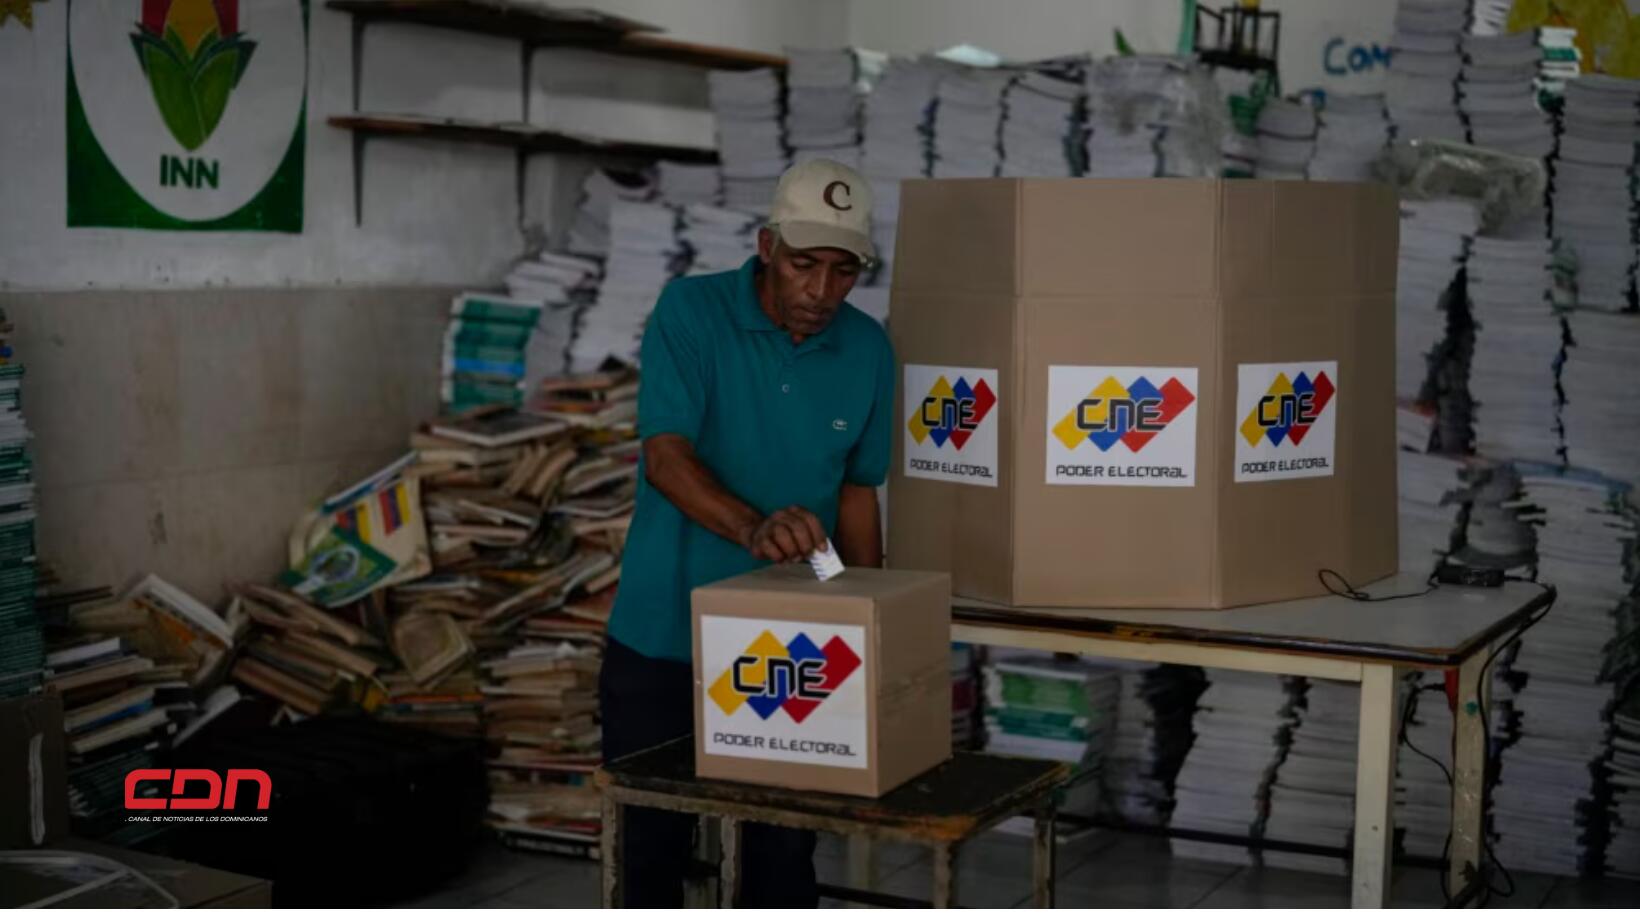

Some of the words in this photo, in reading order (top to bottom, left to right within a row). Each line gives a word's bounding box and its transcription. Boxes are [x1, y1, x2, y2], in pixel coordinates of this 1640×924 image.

[160, 153, 219, 190] INN
[822, 180, 852, 211] C
[921, 396, 979, 430] CNE
[1076, 398, 1168, 431] CNE
[1258, 393, 1318, 427] CNE
[909, 458, 940, 473] PODER
[1055, 464, 1105, 478] PODER
[1107, 465, 1188, 479] ELECTORAL
[1241, 460, 1277, 474] PODER
[732, 655, 833, 699] CNE
[712, 731, 765, 749] PODER
[768, 736, 857, 757] ELECTORAL
